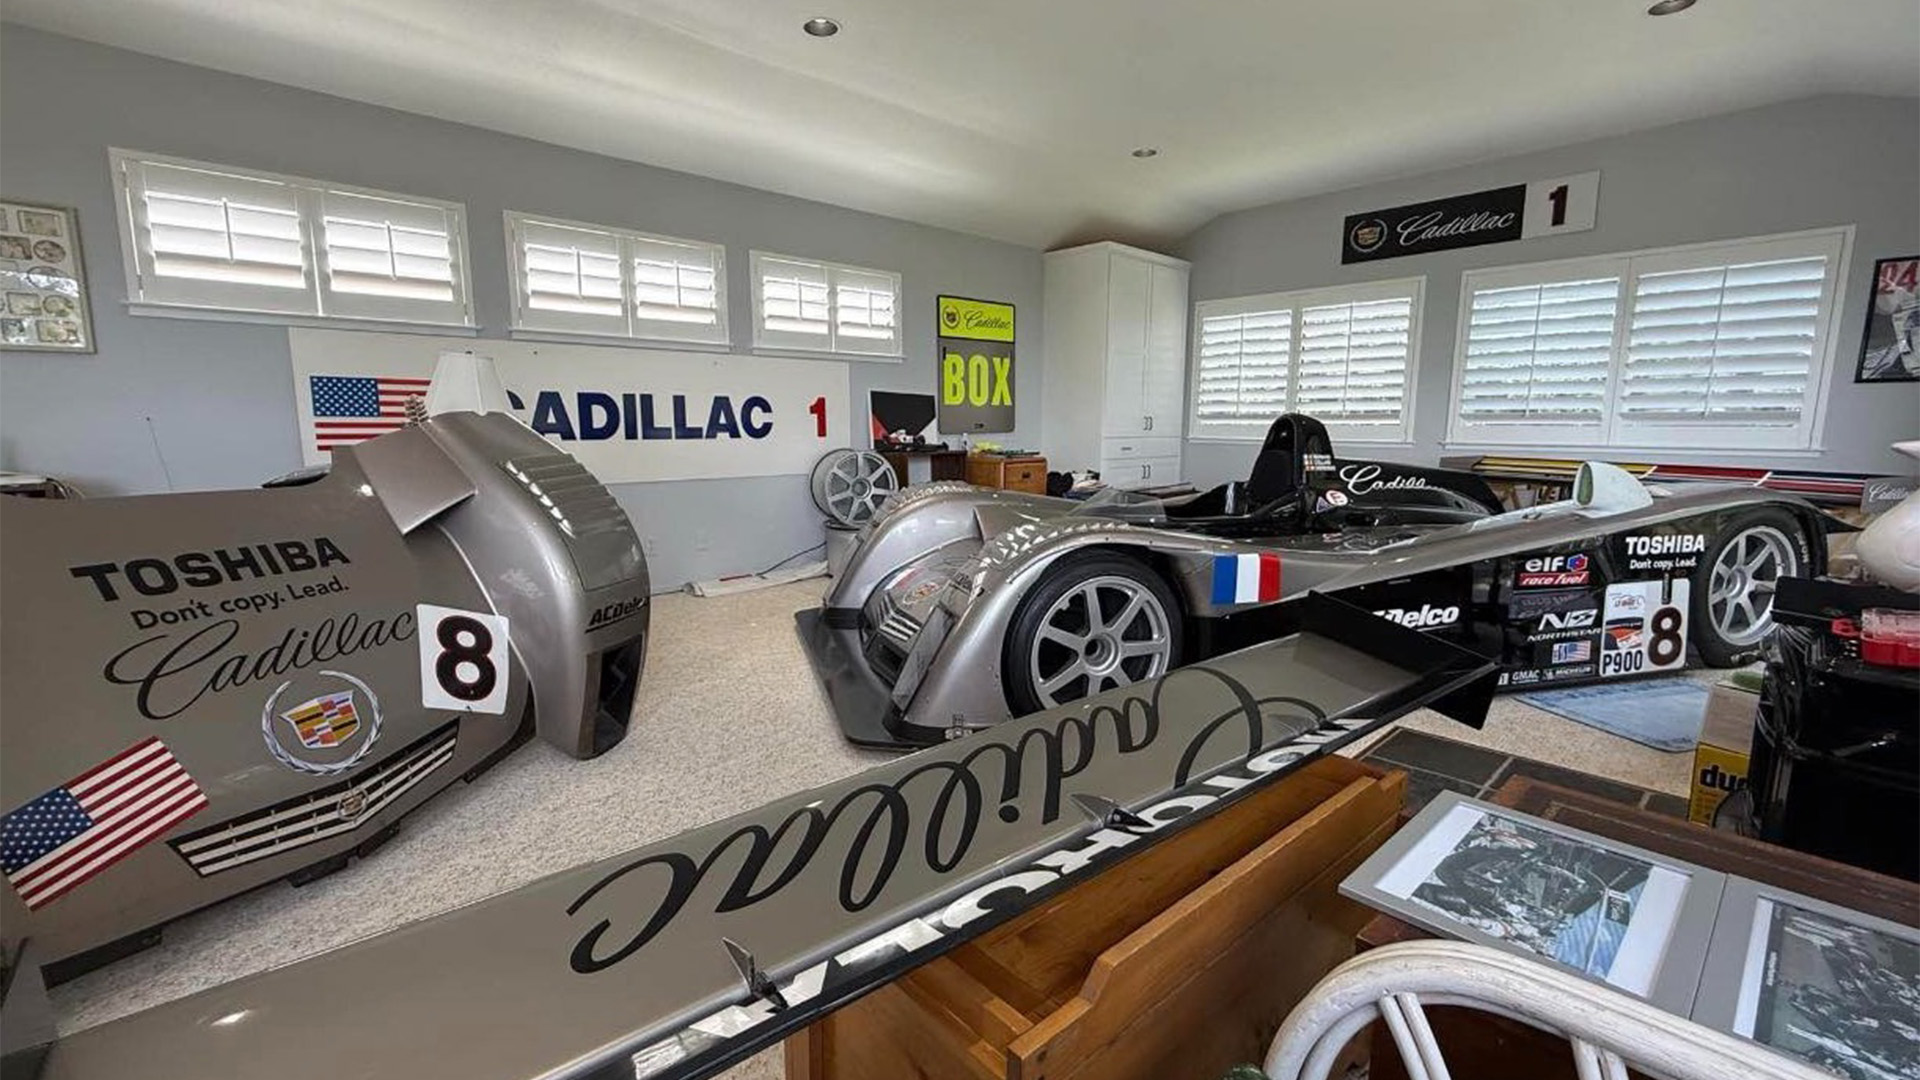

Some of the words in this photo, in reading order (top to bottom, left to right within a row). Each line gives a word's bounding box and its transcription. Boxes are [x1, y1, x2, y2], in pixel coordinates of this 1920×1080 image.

[1397, 211, 1515, 246] Cadillac
[1548, 185, 1569, 227] 1
[964, 310, 1011, 330] Cadillac
[944, 353, 1012, 407] BOX
[506, 389, 773, 441] ADILLAC
[809, 397, 827, 438] 1
[1340, 464, 1445, 495] Cadill
[1525, 556, 1565, 573] elf
[1625, 534, 1705, 556] TOSHIBA
[1629, 558, 1651, 570] Don't
[1675, 556, 1697, 568] Lead.
[70, 537, 351, 602] TOSHIBA
[130, 598, 213, 631] Don't
[219, 588, 285, 616] copy.
[287, 575, 349, 600] Lead.
[1373, 604, 1459, 629] Delco
[1527, 627, 1602, 643] NORTHSTAR
[1648, 606, 1683, 666] 8
[103, 611, 416, 720] Cadillac
[435, 614, 497, 701] 8
[1512, 669, 1540, 681] GMAC
[1602, 649, 1643, 675] P900
[566, 667, 1327, 974] Cadillac
